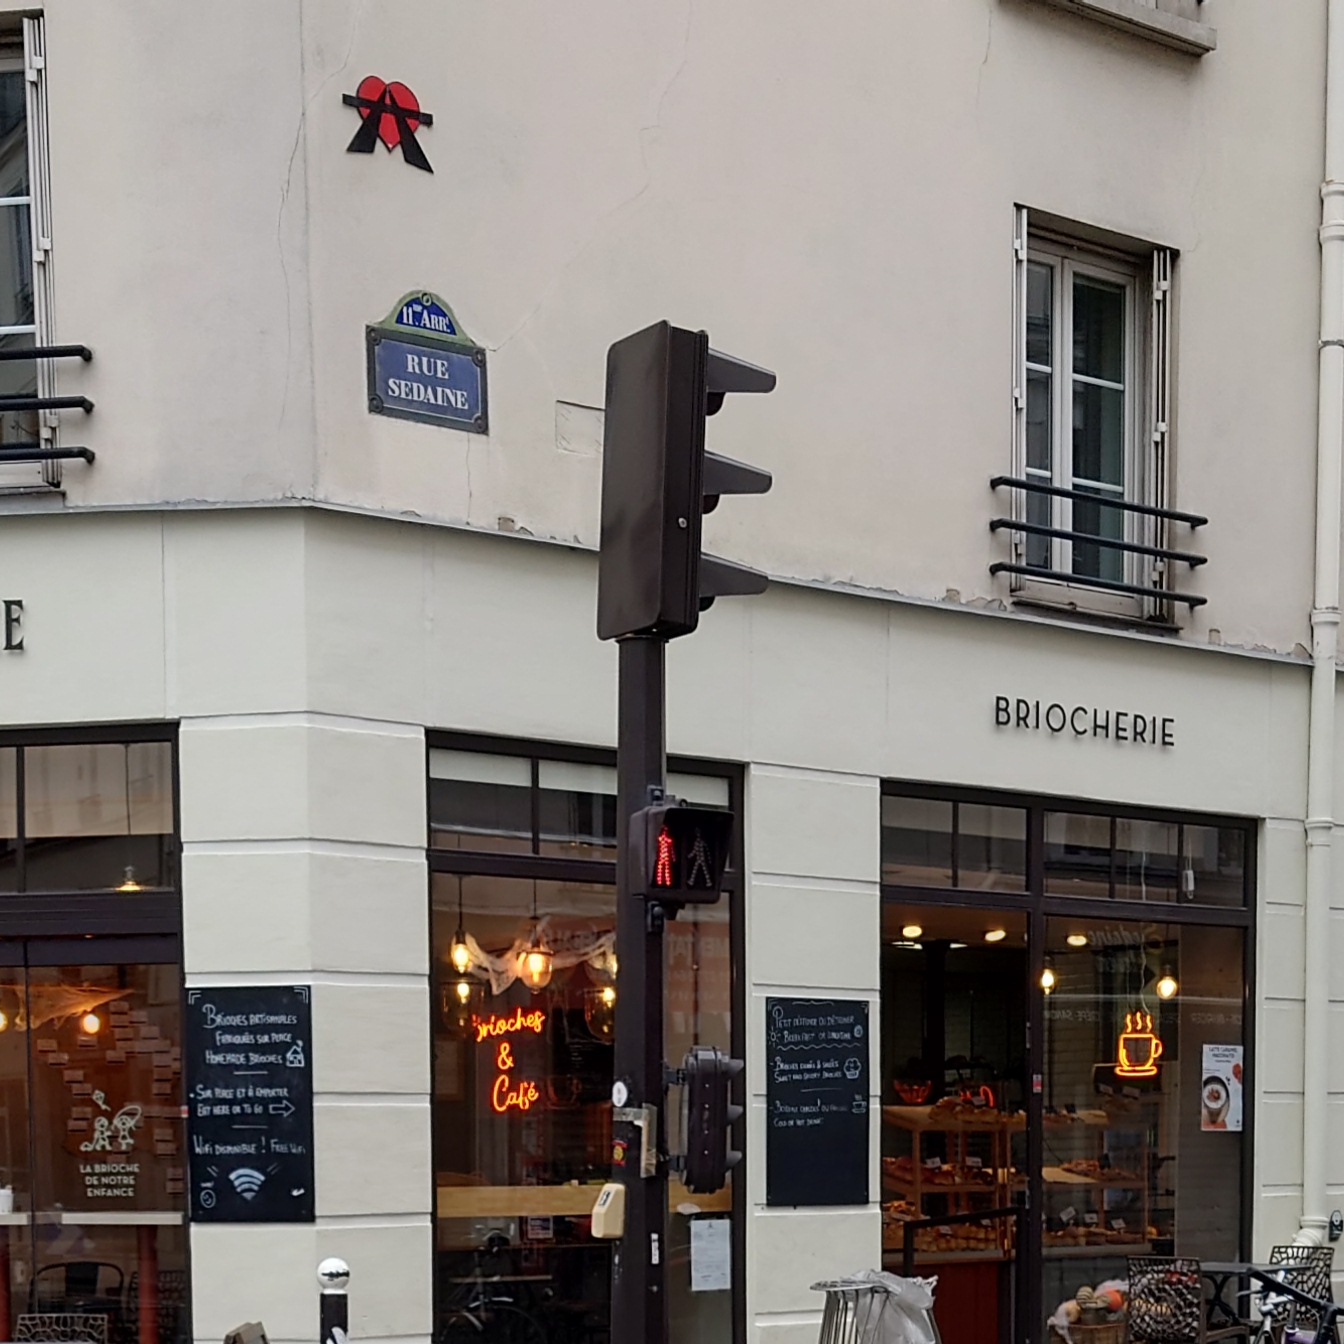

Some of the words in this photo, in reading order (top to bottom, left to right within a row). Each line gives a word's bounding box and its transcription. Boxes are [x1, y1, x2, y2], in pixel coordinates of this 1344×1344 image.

[406, 353, 449, 379] RUE
[388, 377, 469, 410] SEDAINE
[994, 696, 1175, 747] BRIOCHERIE
[498, 1042, 514, 1070] &
[493, 1074, 540, 1112] Café
[80, 1164, 92, 1173] LA
[94, 1163, 140, 1173] BRIOCHE
[85, 1176, 99, 1185] DE
[101, 1175, 135, 1185] NOTRE
[86, 1187, 135, 1197] ENFANCE
